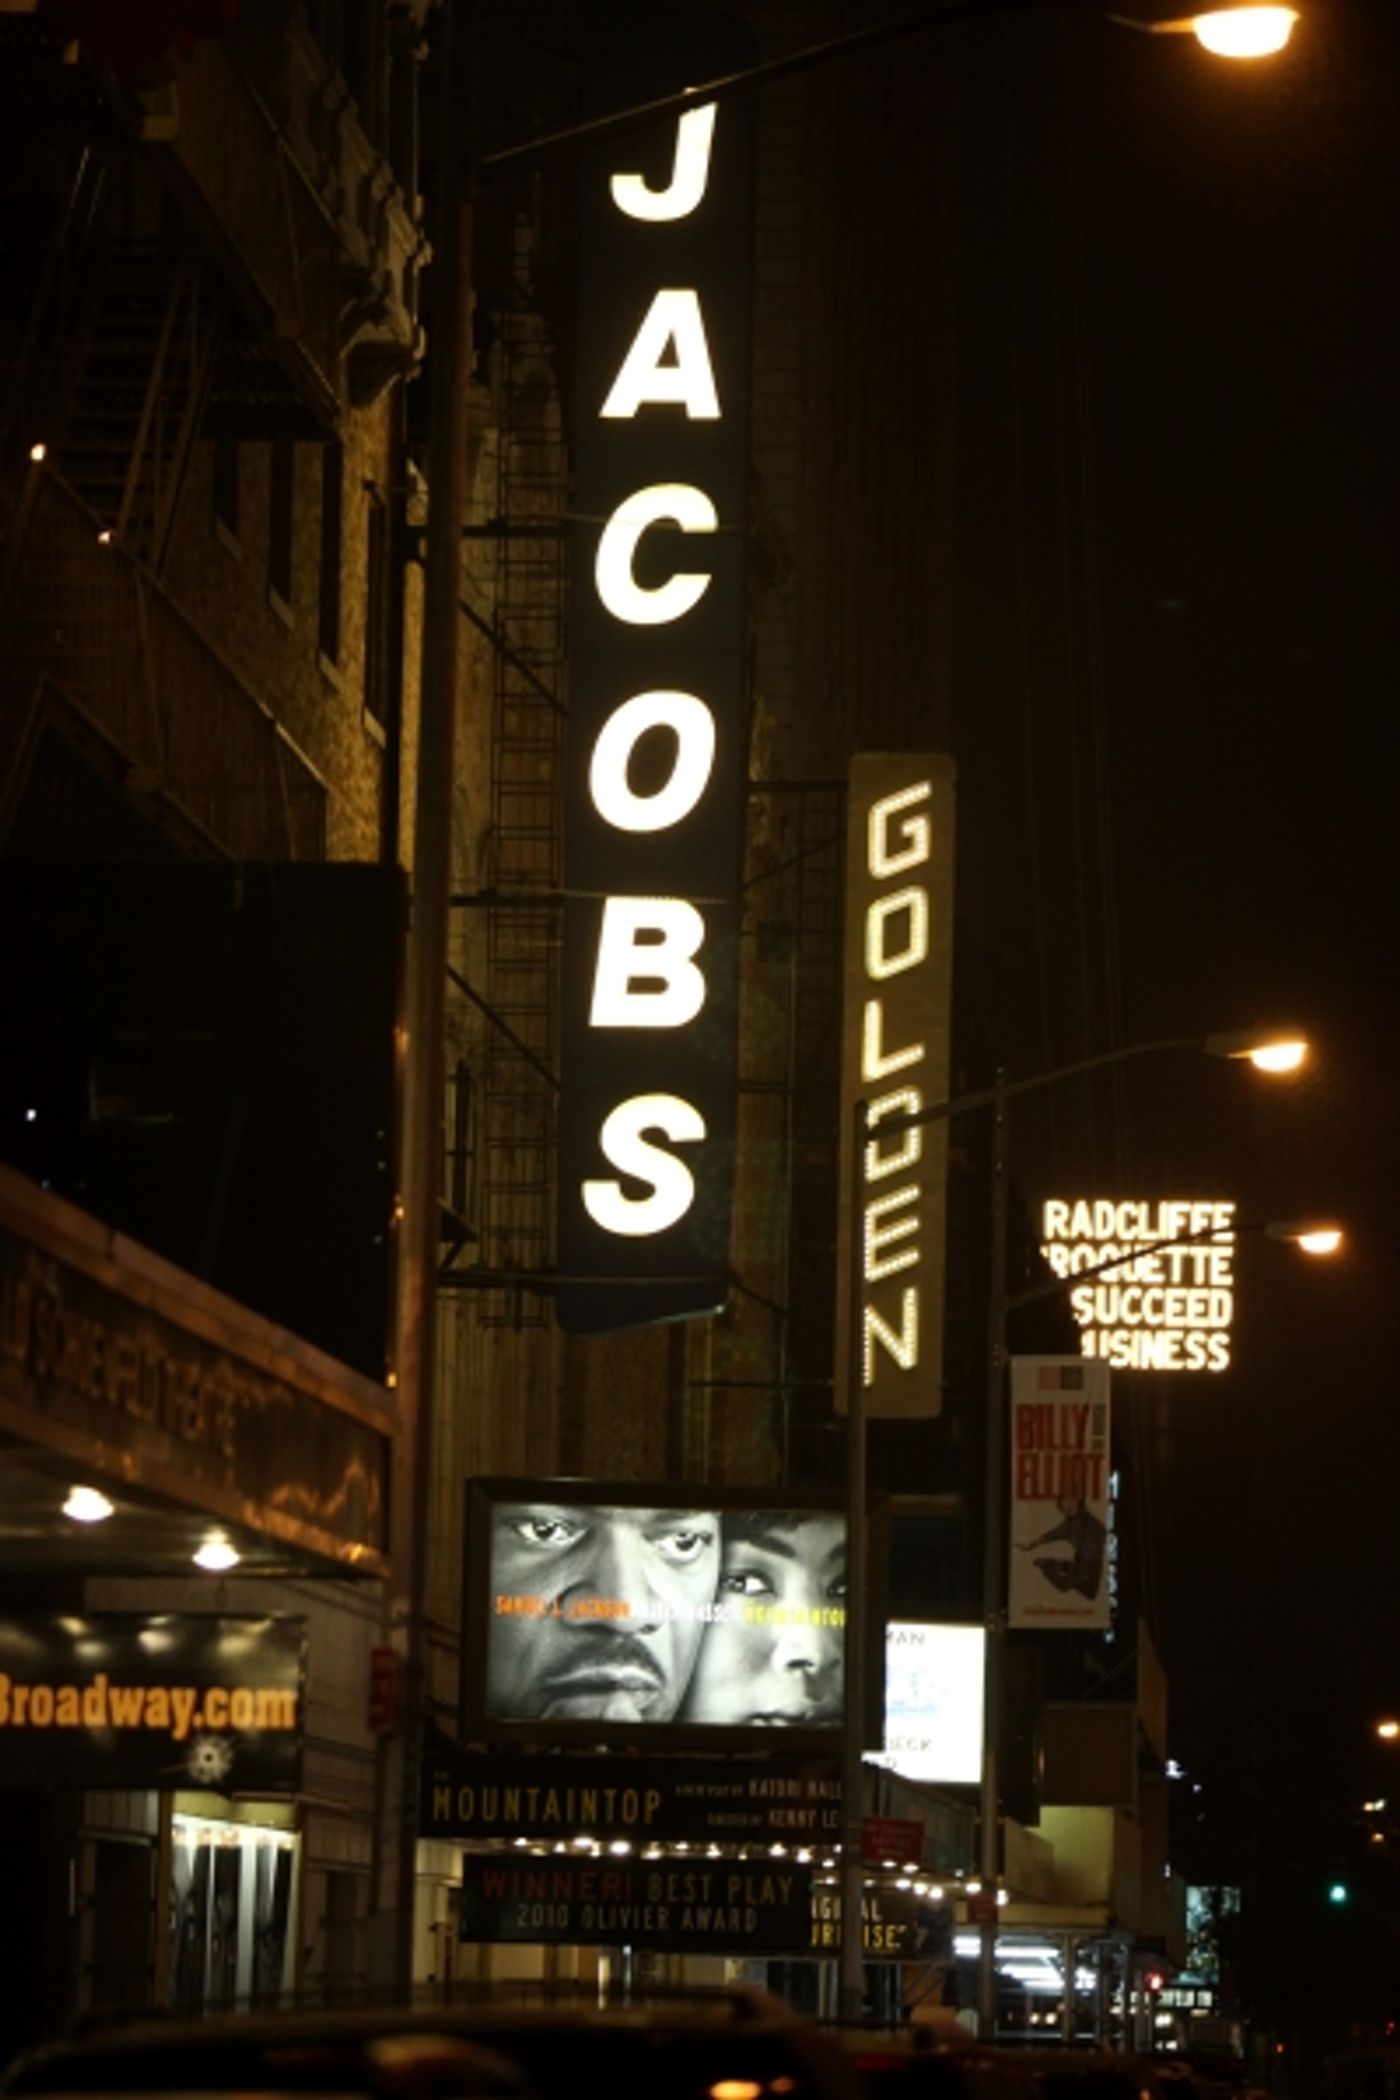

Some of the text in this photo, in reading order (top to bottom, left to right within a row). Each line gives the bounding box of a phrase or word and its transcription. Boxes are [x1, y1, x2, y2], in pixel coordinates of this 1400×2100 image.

[582, 88, 721, 1236] JACOBS
[862, 782, 931, 1387] GOLDEN
[1044, 1200, 1236, 1243] RADCLIFFE
[1040, 1242, 1234, 1286] ROQUETTE
[1071, 1286, 1233, 1328] SUCCEED
[1081, 1328, 1230, 1372] USINESS
[1016, 1404, 1089, 1450] BILLY
[432, 1784, 662, 1826] MOUNTAINTOP
[481, 1868, 793, 1907] WINNER! BEST PLAY
[517, 1903, 759, 1935] 2010 OLIVIER AWARD
